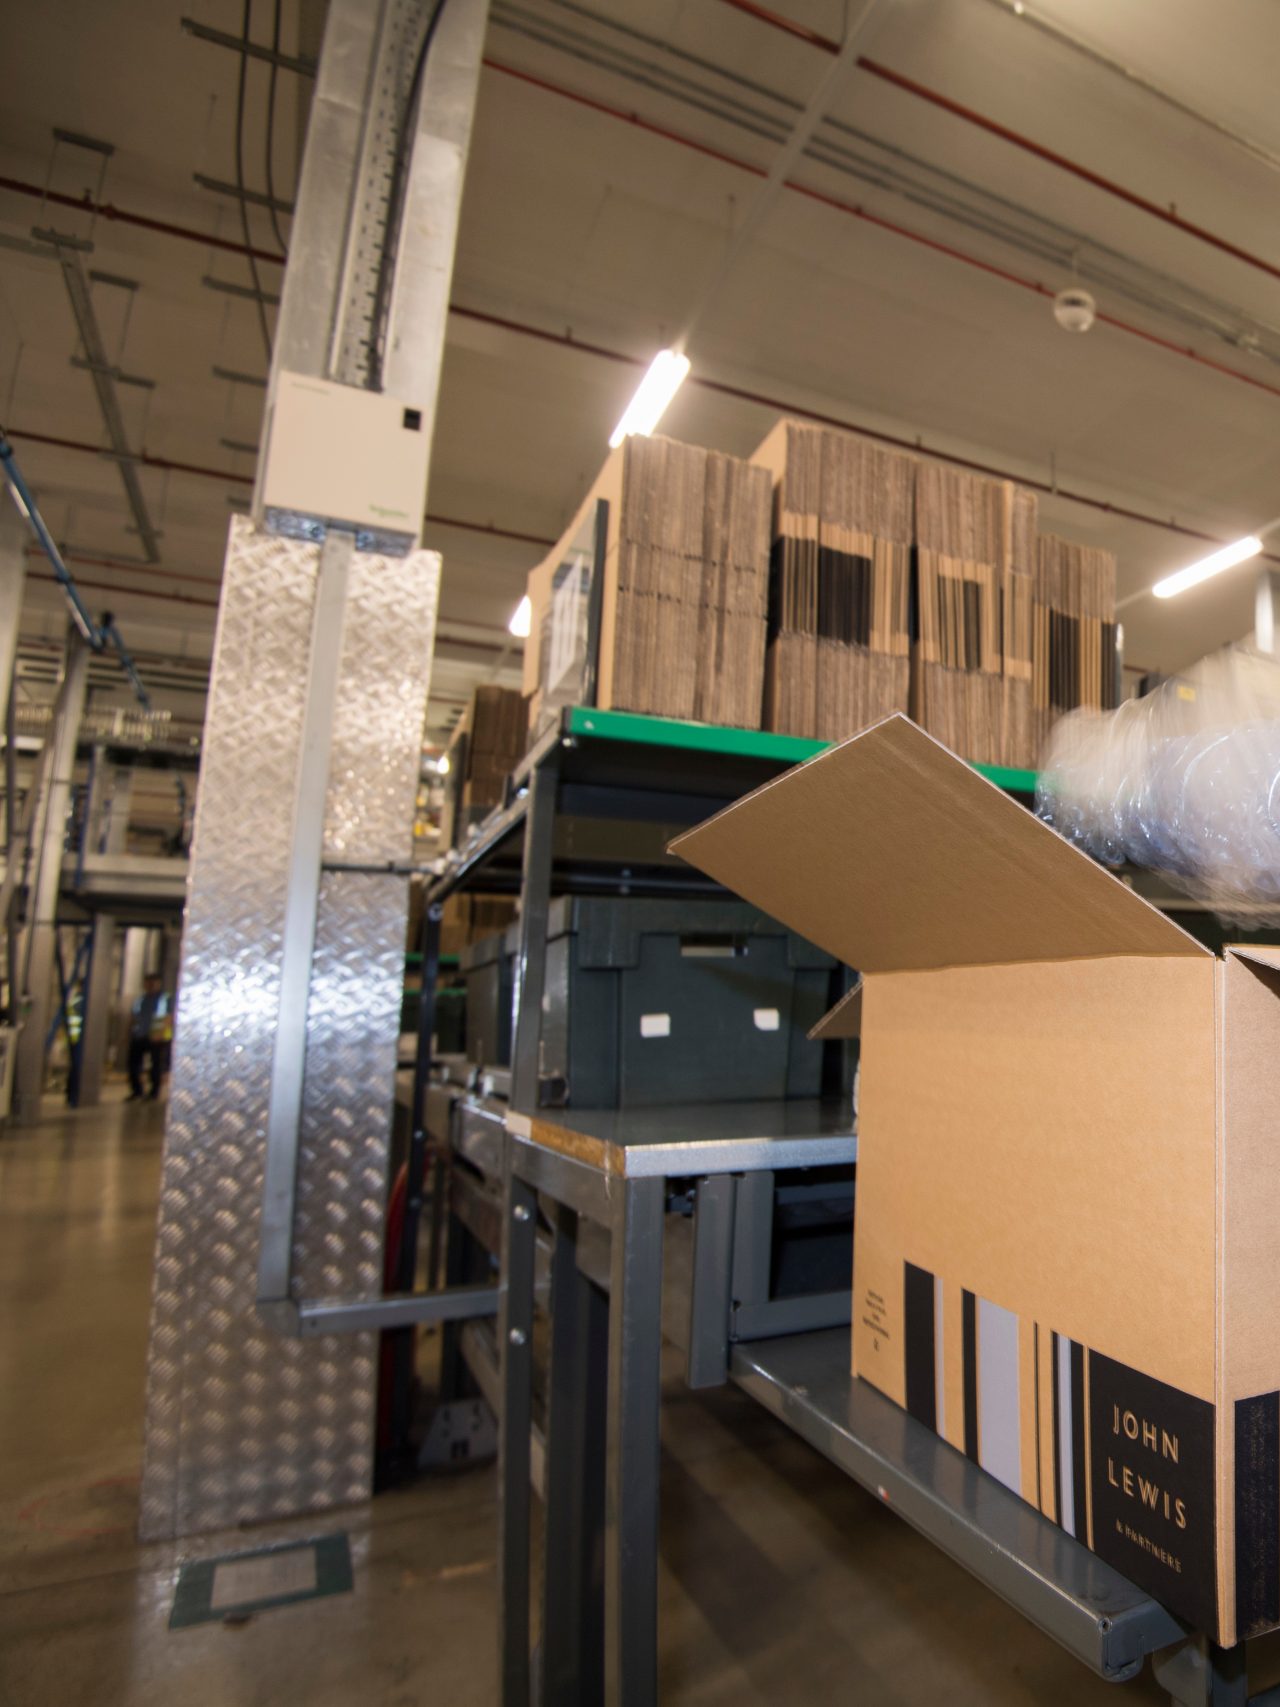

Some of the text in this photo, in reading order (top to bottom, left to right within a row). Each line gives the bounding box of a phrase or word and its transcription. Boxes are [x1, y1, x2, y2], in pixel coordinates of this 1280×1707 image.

[1112, 1404, 1179, 1464] JOHN
[1107, 1456, 1187, 1529] LEWIS
[1124, 1527, 1182, 1573] PARTNERS
